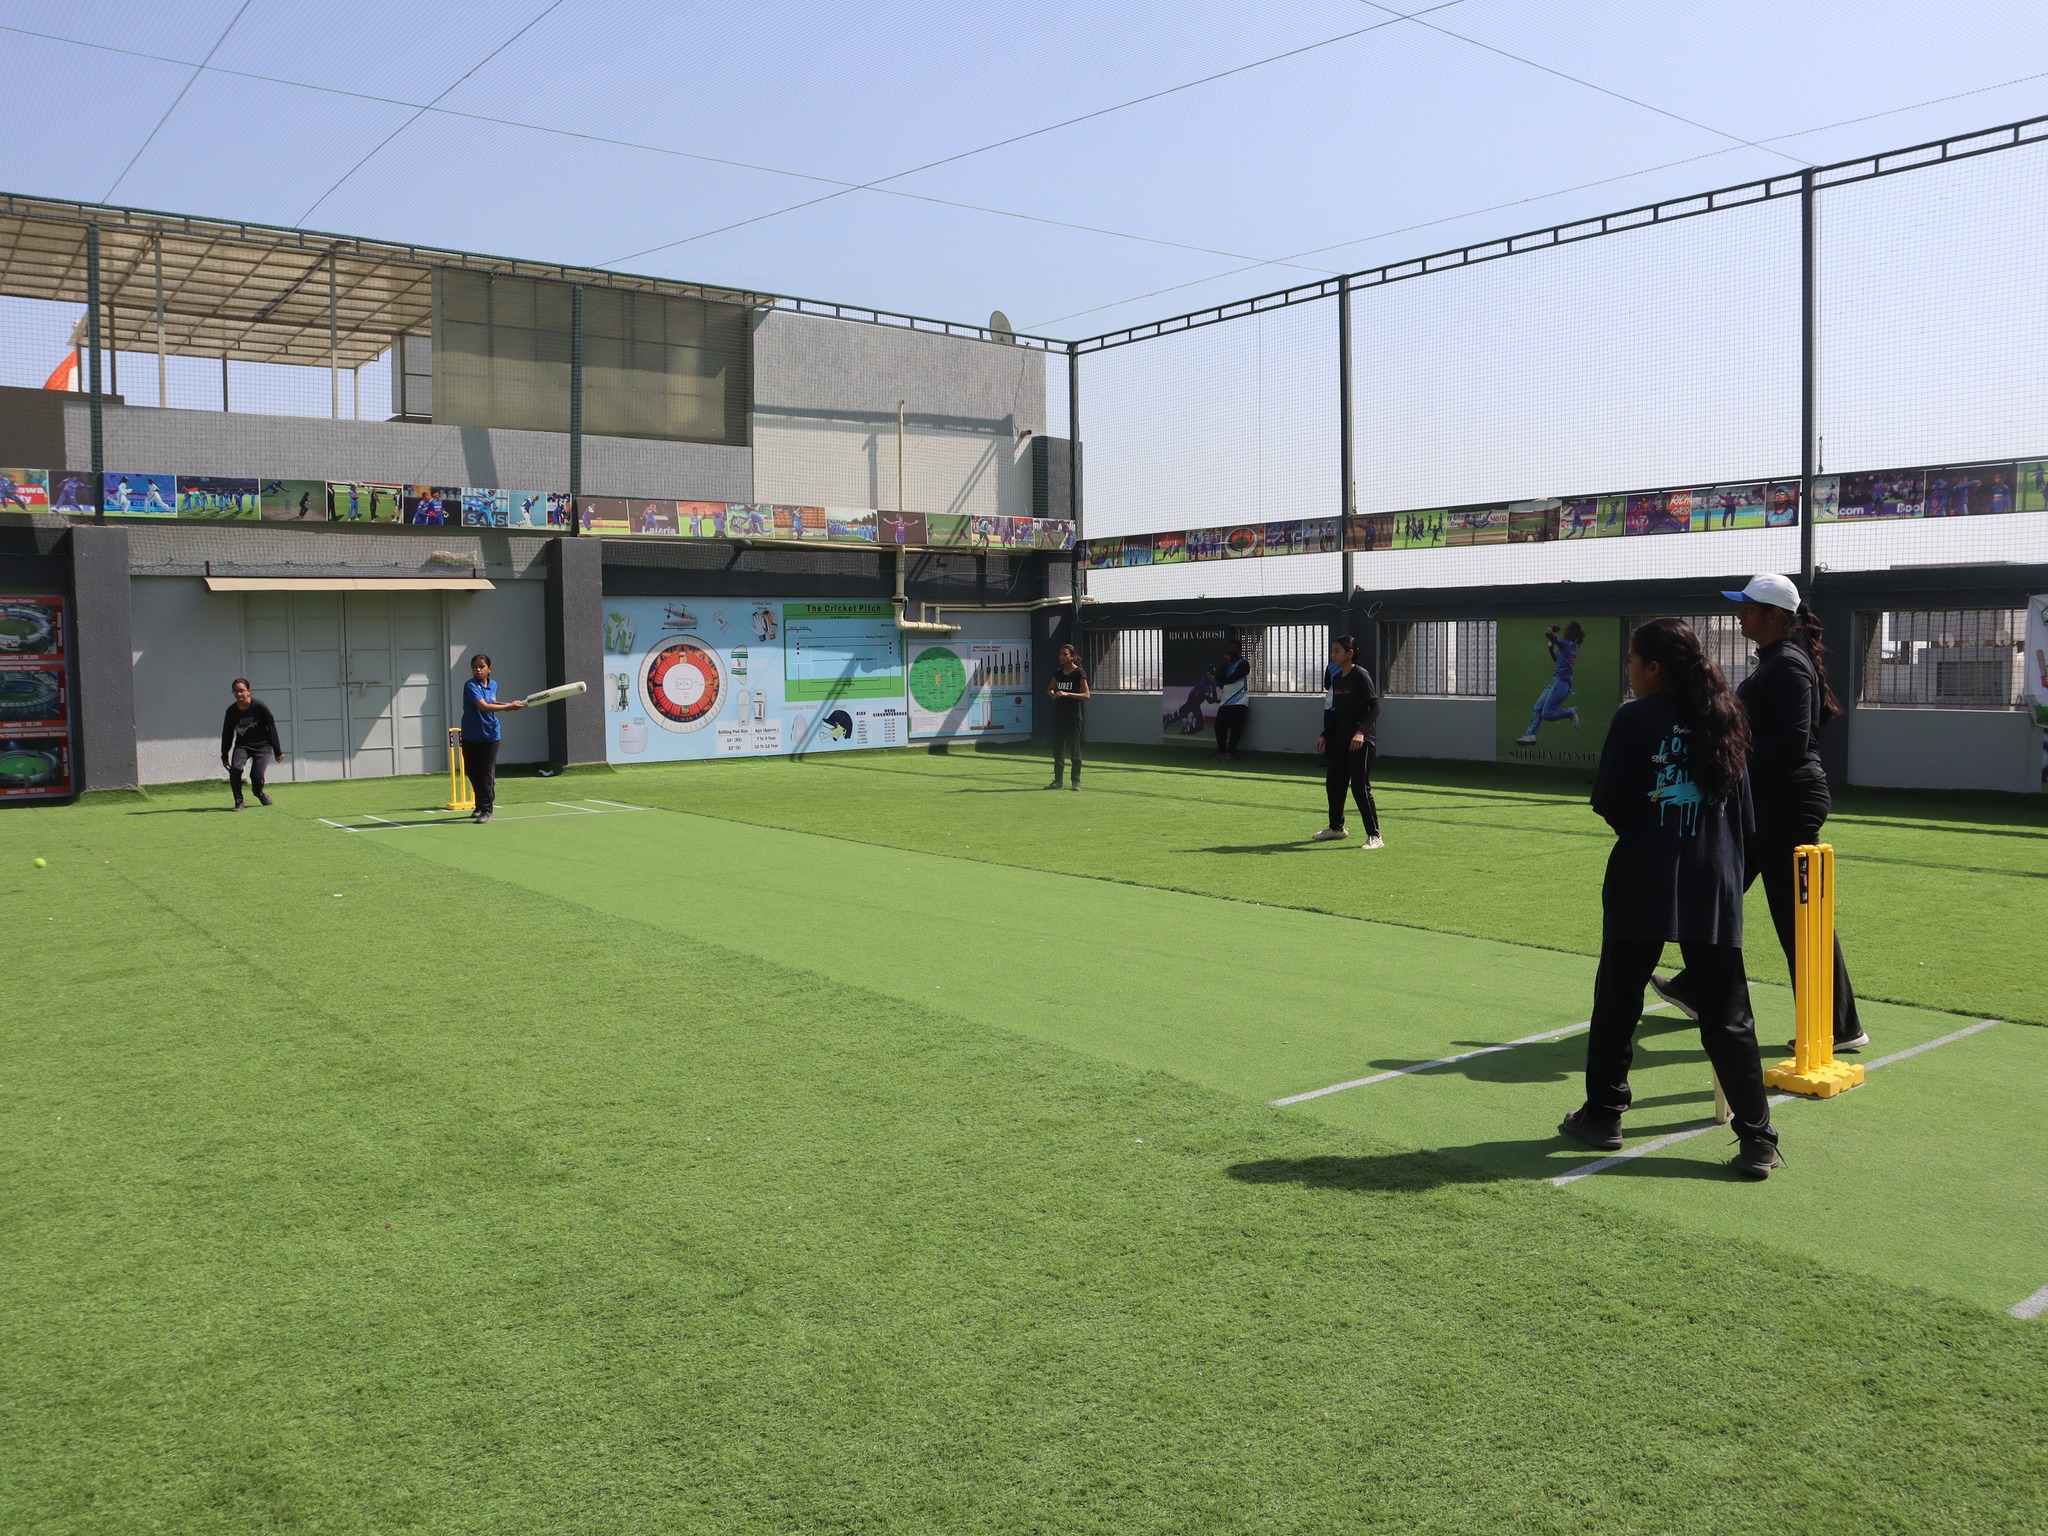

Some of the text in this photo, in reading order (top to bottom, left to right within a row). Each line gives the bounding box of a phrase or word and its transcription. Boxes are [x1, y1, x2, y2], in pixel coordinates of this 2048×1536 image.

[807, 604, 881, 612] The Cricket Pitch
[1169, 630, 1225, 640] RICHA GHOSH
[1509, 749, 1601, 762] SHIKHA PANDE
